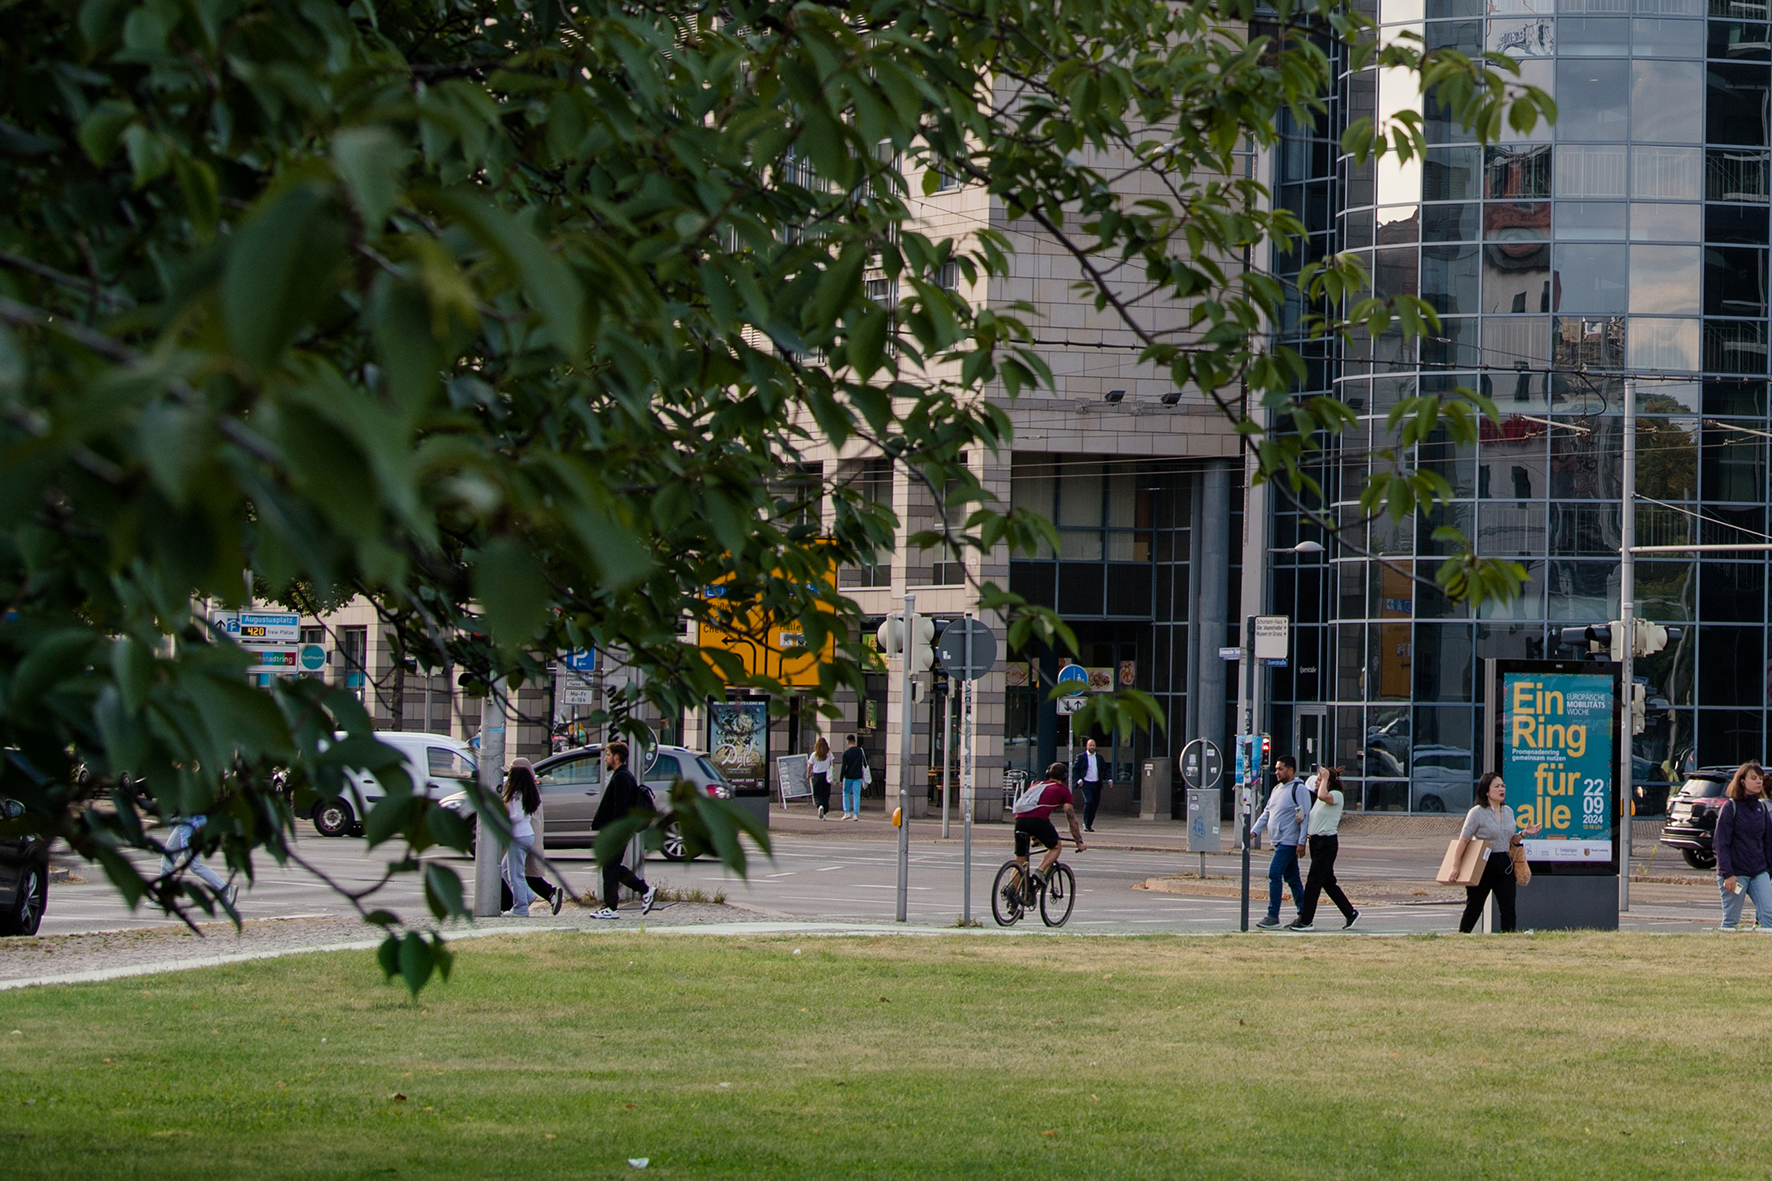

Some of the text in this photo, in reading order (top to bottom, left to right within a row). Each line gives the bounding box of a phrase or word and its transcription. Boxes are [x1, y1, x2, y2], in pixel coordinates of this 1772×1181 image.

[245, 616, 293, 625] Augustusplatz
[247, 627, 265, 636] 420
[1513, 682, 1564, 715] Ein
[1567, 693, 1605, 701] EUROPÄISCHE
[1567, 700, 1606, 709] MOBILITÄTS
[1512, 716, 1586, 757] Ring
[1534, 763, 1581, 796] für
[1583, 779, 1604, 796] 22
[1516, 797, 1571, 829] alle
[1583, 797, 1604, 814] 09
[1583, 815, 1603, 824] 2024
